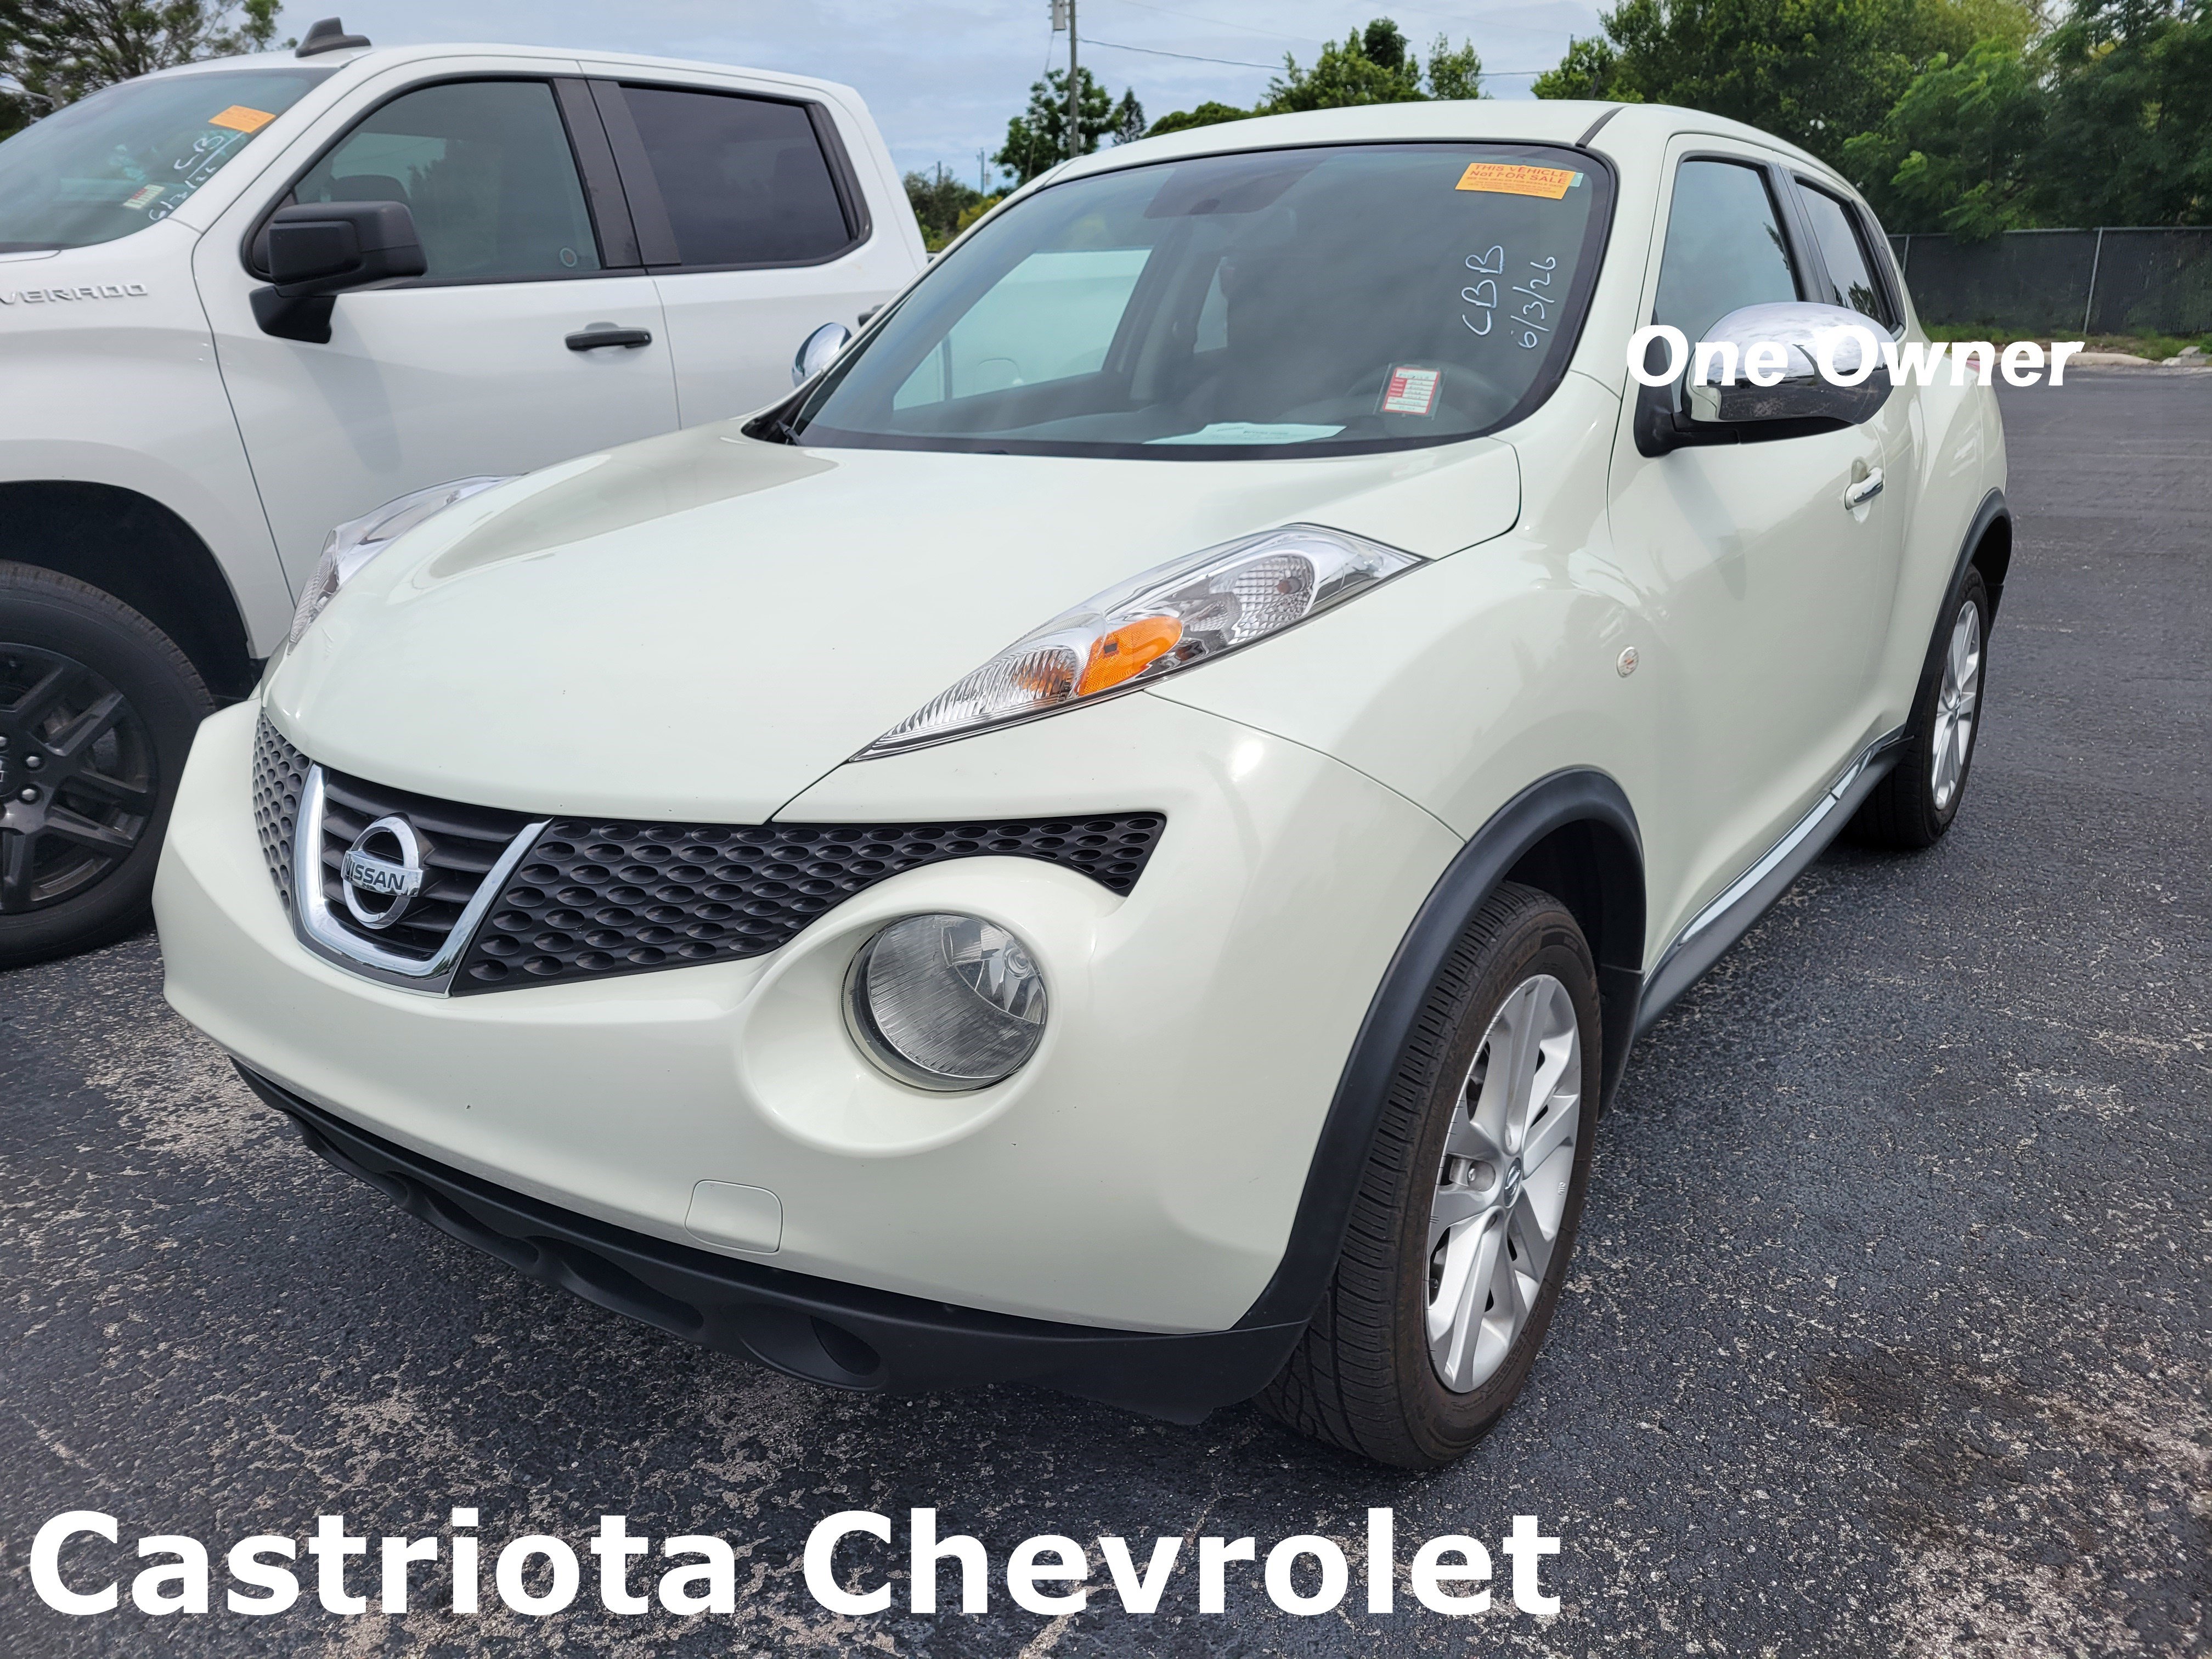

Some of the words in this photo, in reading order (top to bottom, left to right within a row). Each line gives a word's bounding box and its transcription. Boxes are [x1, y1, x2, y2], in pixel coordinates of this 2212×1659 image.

[1509, 166, 1570, 177] VEHICLE
[1530, 174, 1567, 184] SALE
[1461, 245, 1504, 336] CBB
[1510, 256, 1556, 348] 6/3/26
[344, 856, 405, 890] NISSAN
